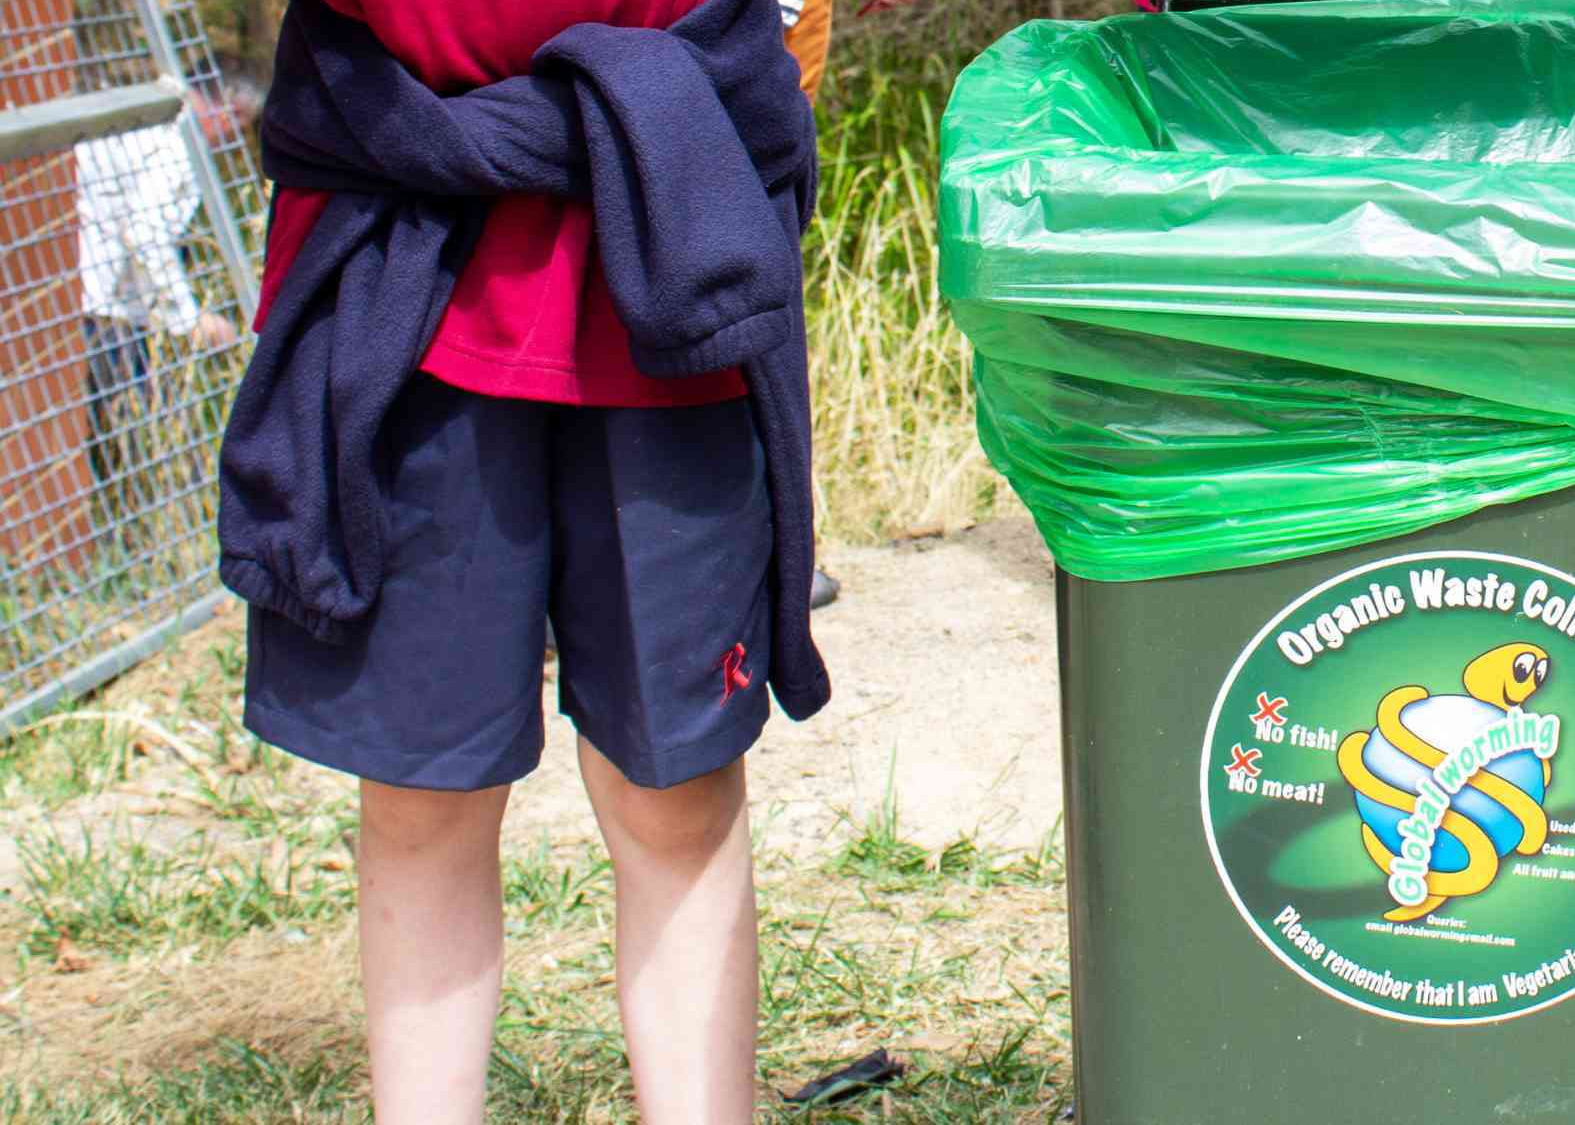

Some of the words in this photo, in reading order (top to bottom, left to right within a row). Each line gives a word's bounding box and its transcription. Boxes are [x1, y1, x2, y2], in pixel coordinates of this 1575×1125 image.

[1276, 583, 1405, 665] Organic
[1409, 568, 1516, 612] Waste
[1255, 719, 1285, 743] No
[1289, 724, 1338, 751] fish!
[1229, 770, 1257, 794] No
[1261, 779, 1325, 805] meat!
[1542, 843, 1575, 857] Cakes
[1512, 863, 1530, 876] All
[1530, 865, 1558, 879] fruit
[1273, 905, 1322, 961] Please
[1322, 949, 1412, 1001] remember
[1415, 979, 1455, 1006] that
[1457, 980, 1465, 1006] I
[1467, 981, 1499, 1006] am
